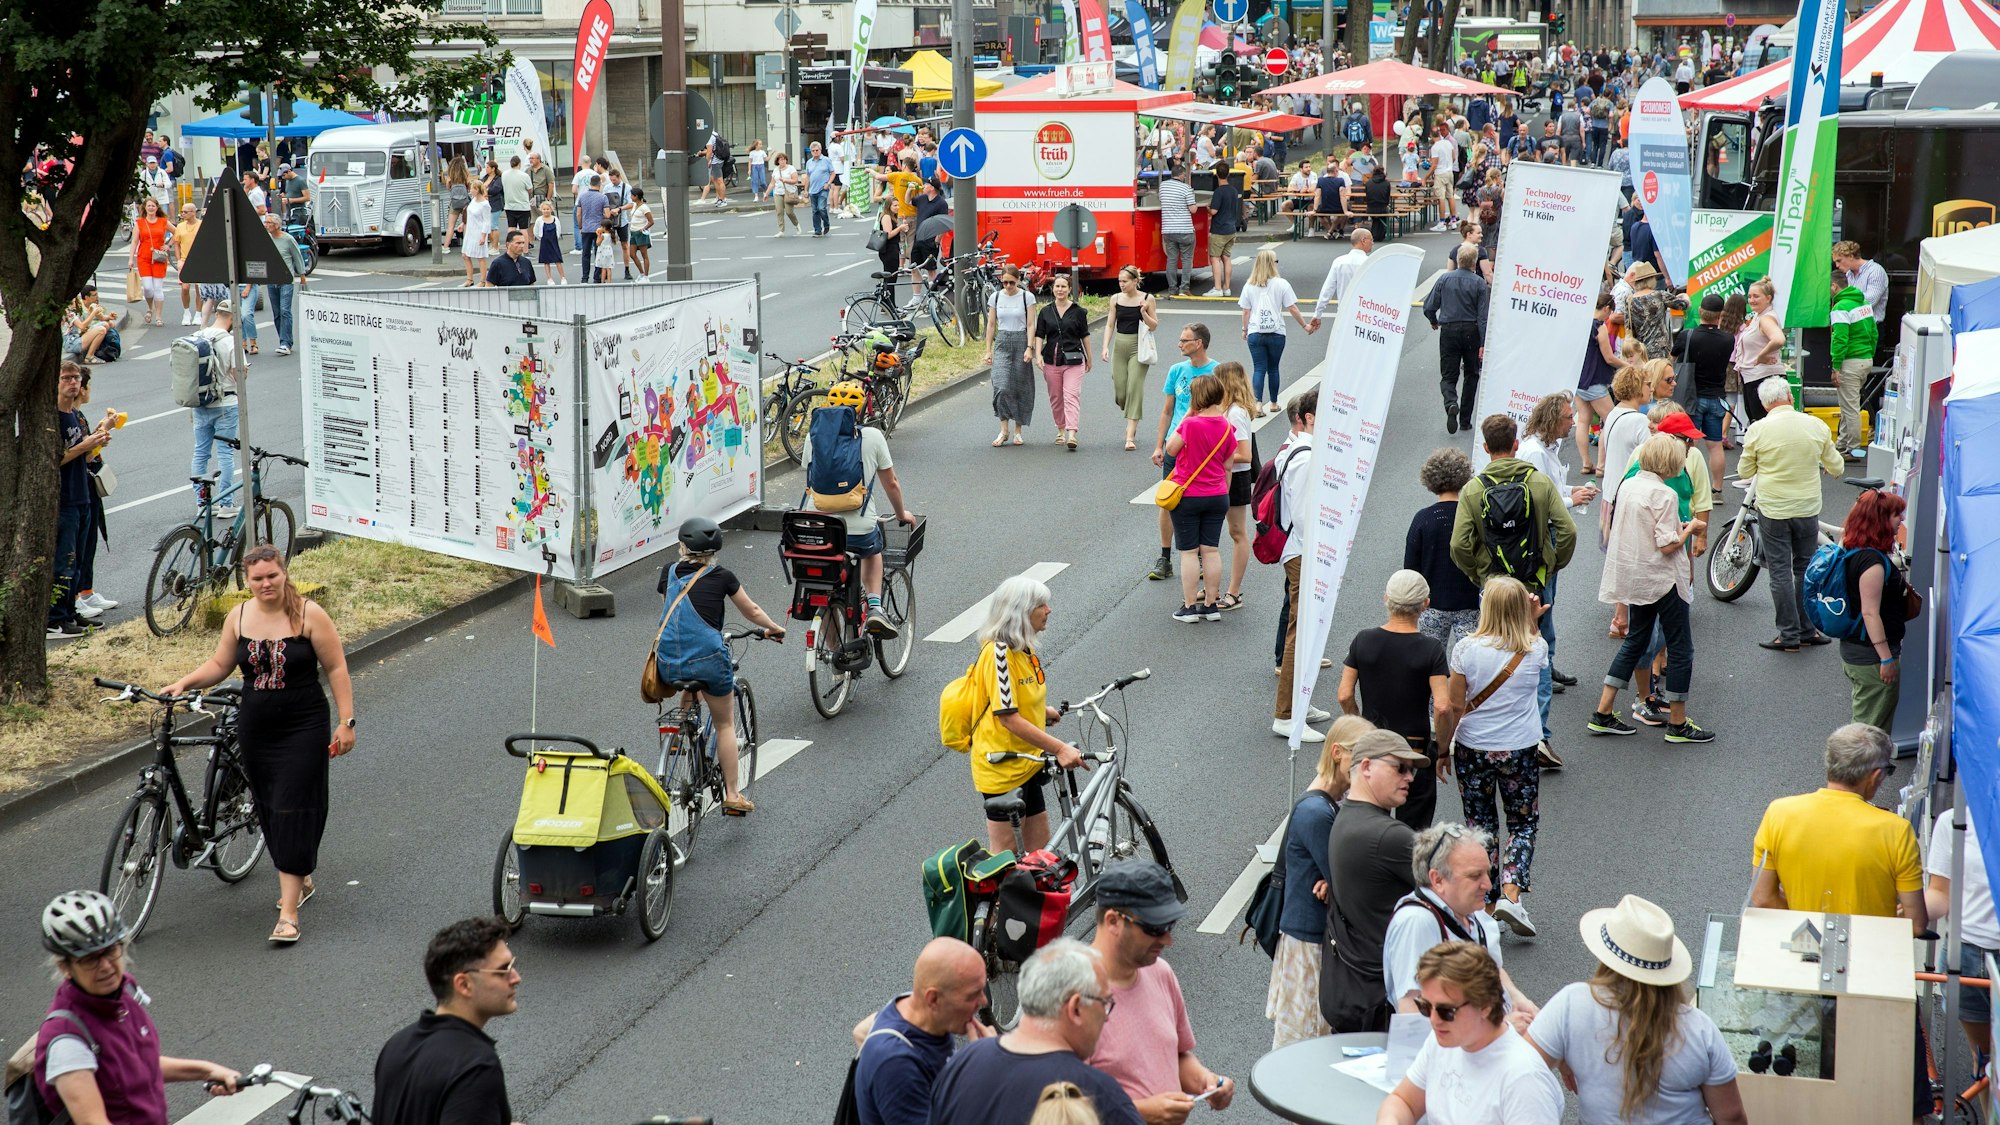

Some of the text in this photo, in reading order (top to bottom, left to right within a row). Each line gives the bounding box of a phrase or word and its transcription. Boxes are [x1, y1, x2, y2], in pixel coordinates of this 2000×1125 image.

[1830, 0, 1838, 25] LOGIST
[1085, 18, 1106, 62] IK
[1817, 0, 1833, 61] WIRTSCHAFTS
[576, 14, 609, 92] REWE
[1133, 18, 1158, 87] IKE
[1040, 146, 1068, 162] früh
[1023, 187, 1084, 198] www.frueh.de
[1525, 187, 1572, 203] Technology
[1002, 200, 1107, 209] CÖLNER HOFBR FRÜH
[1523, 198, 1576, 213] Arts Sciences
[1523, 209, 1555, 222] TH Köln
[1694, 213, 1729, 228] JITpay
[1777, 179, 1807, 254] JITpay
[1692, 243, 1726, 272] MAKE
[1696, 244, 1756, 287] TRUCKING
[1514, 264, 1585, 289] Technology
[1702, 271, 1741, 298] GREAT
[1512, 281, 1588, 305] Arts Sciences
[1358, 296, 1401, 320] Technology
[1510, 297, 1558, 318] TH Köln
[343, 312, 382, 329] BEITRÄGE
[1356, 310, 1406, 335] Arts Sciences
[1354, 326, 1385, 345] TH Köln
[451, 342, 475, 361] land
[1508, 400, 1523, 411] Arts
[1510, 389, 1542, 404] Technolo
[1360, 419, 1381, 430] Technolo
[1518, 412, 1529, 423] Kö
[600, 431, 614, 453] NORD
[1357, 457, 1370, 466] Techn
[312, 505, 327, 516] REWE
